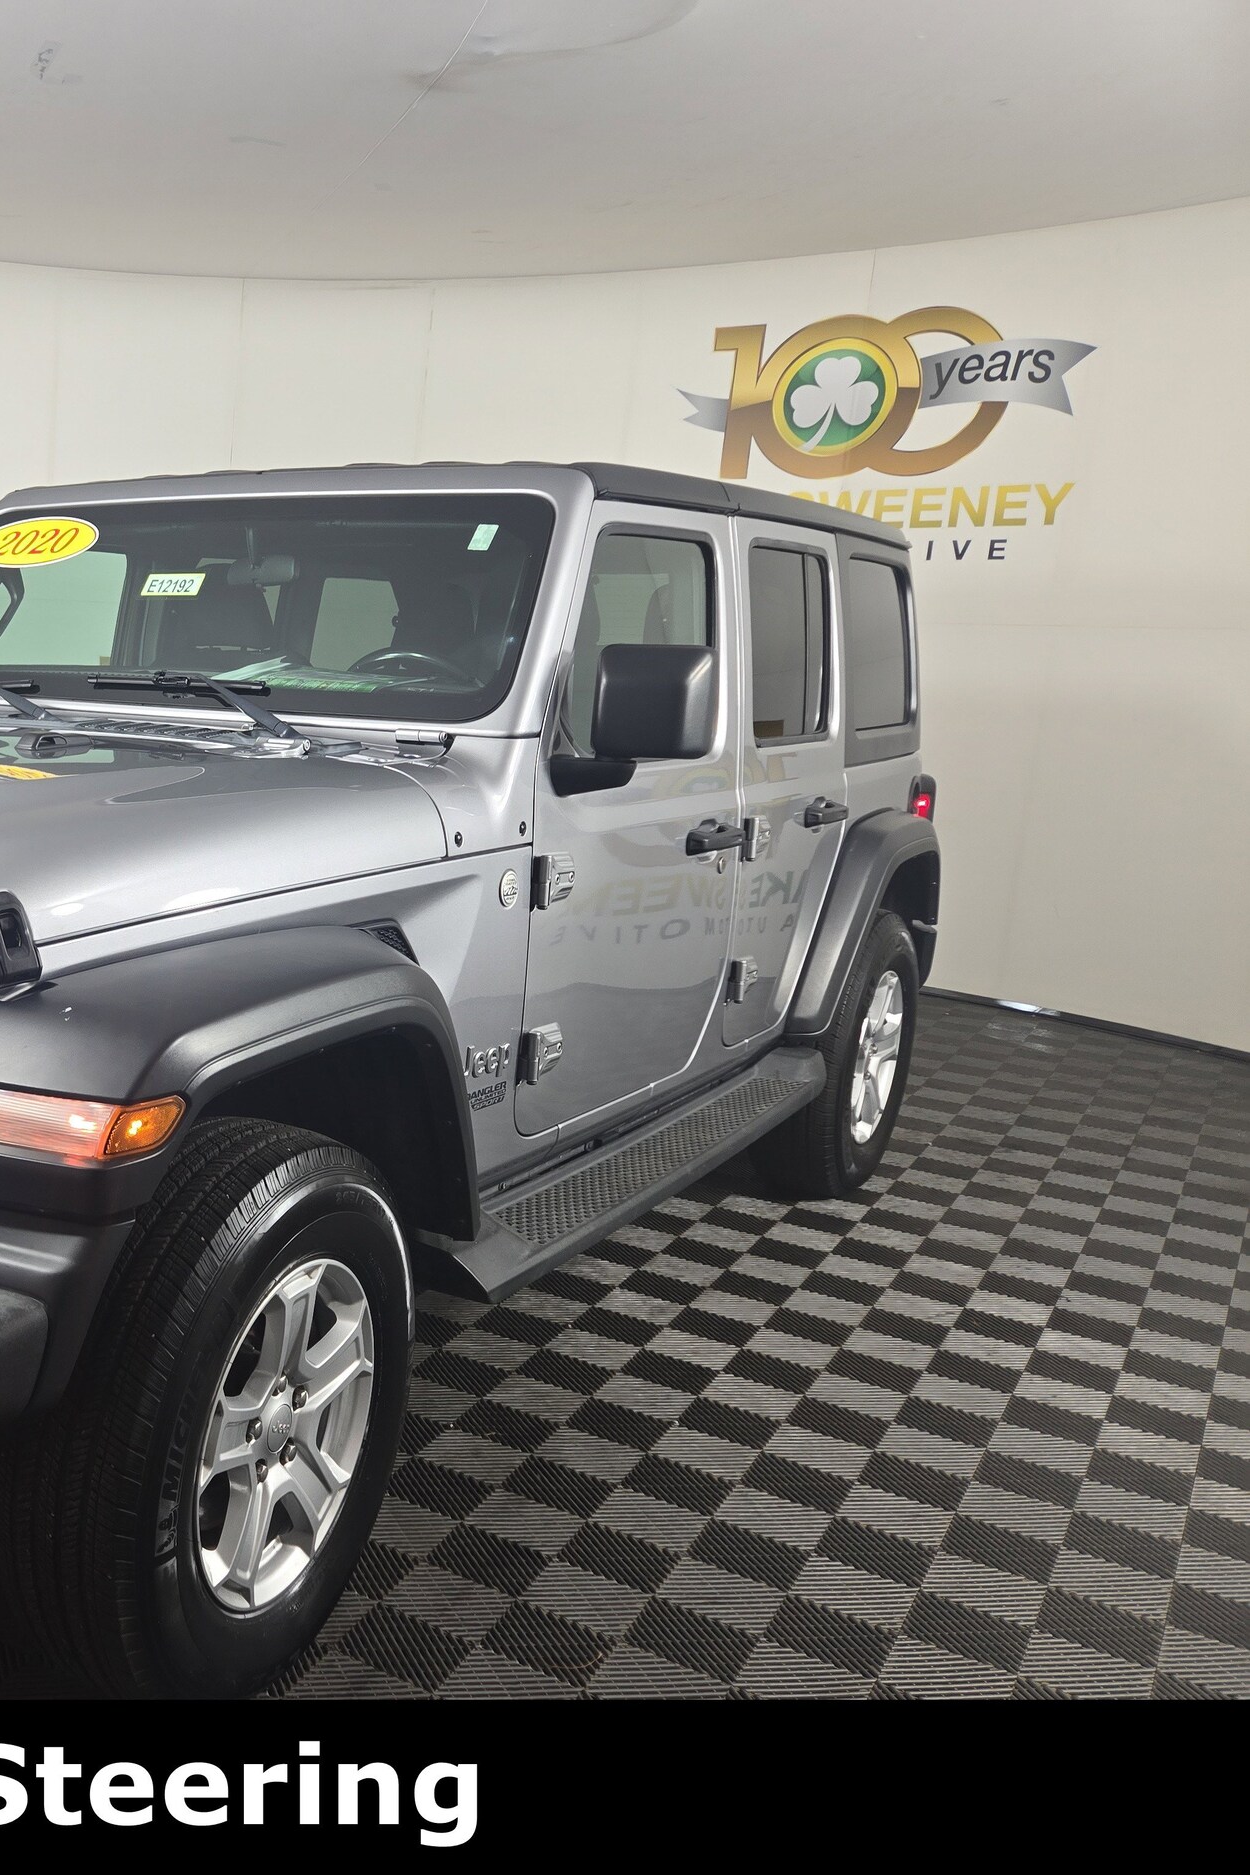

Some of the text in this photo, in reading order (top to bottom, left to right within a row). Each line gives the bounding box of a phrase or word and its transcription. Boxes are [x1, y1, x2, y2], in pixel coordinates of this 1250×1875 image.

[713, 306, 1055, 479] 100 years
[147, 579, 195, 593] E12192
[463, 1043, 510, 1078] Jeep
[467, 1081, 507, 1100] ANGLER
[271, 1420, 290, 1433] Jeep
